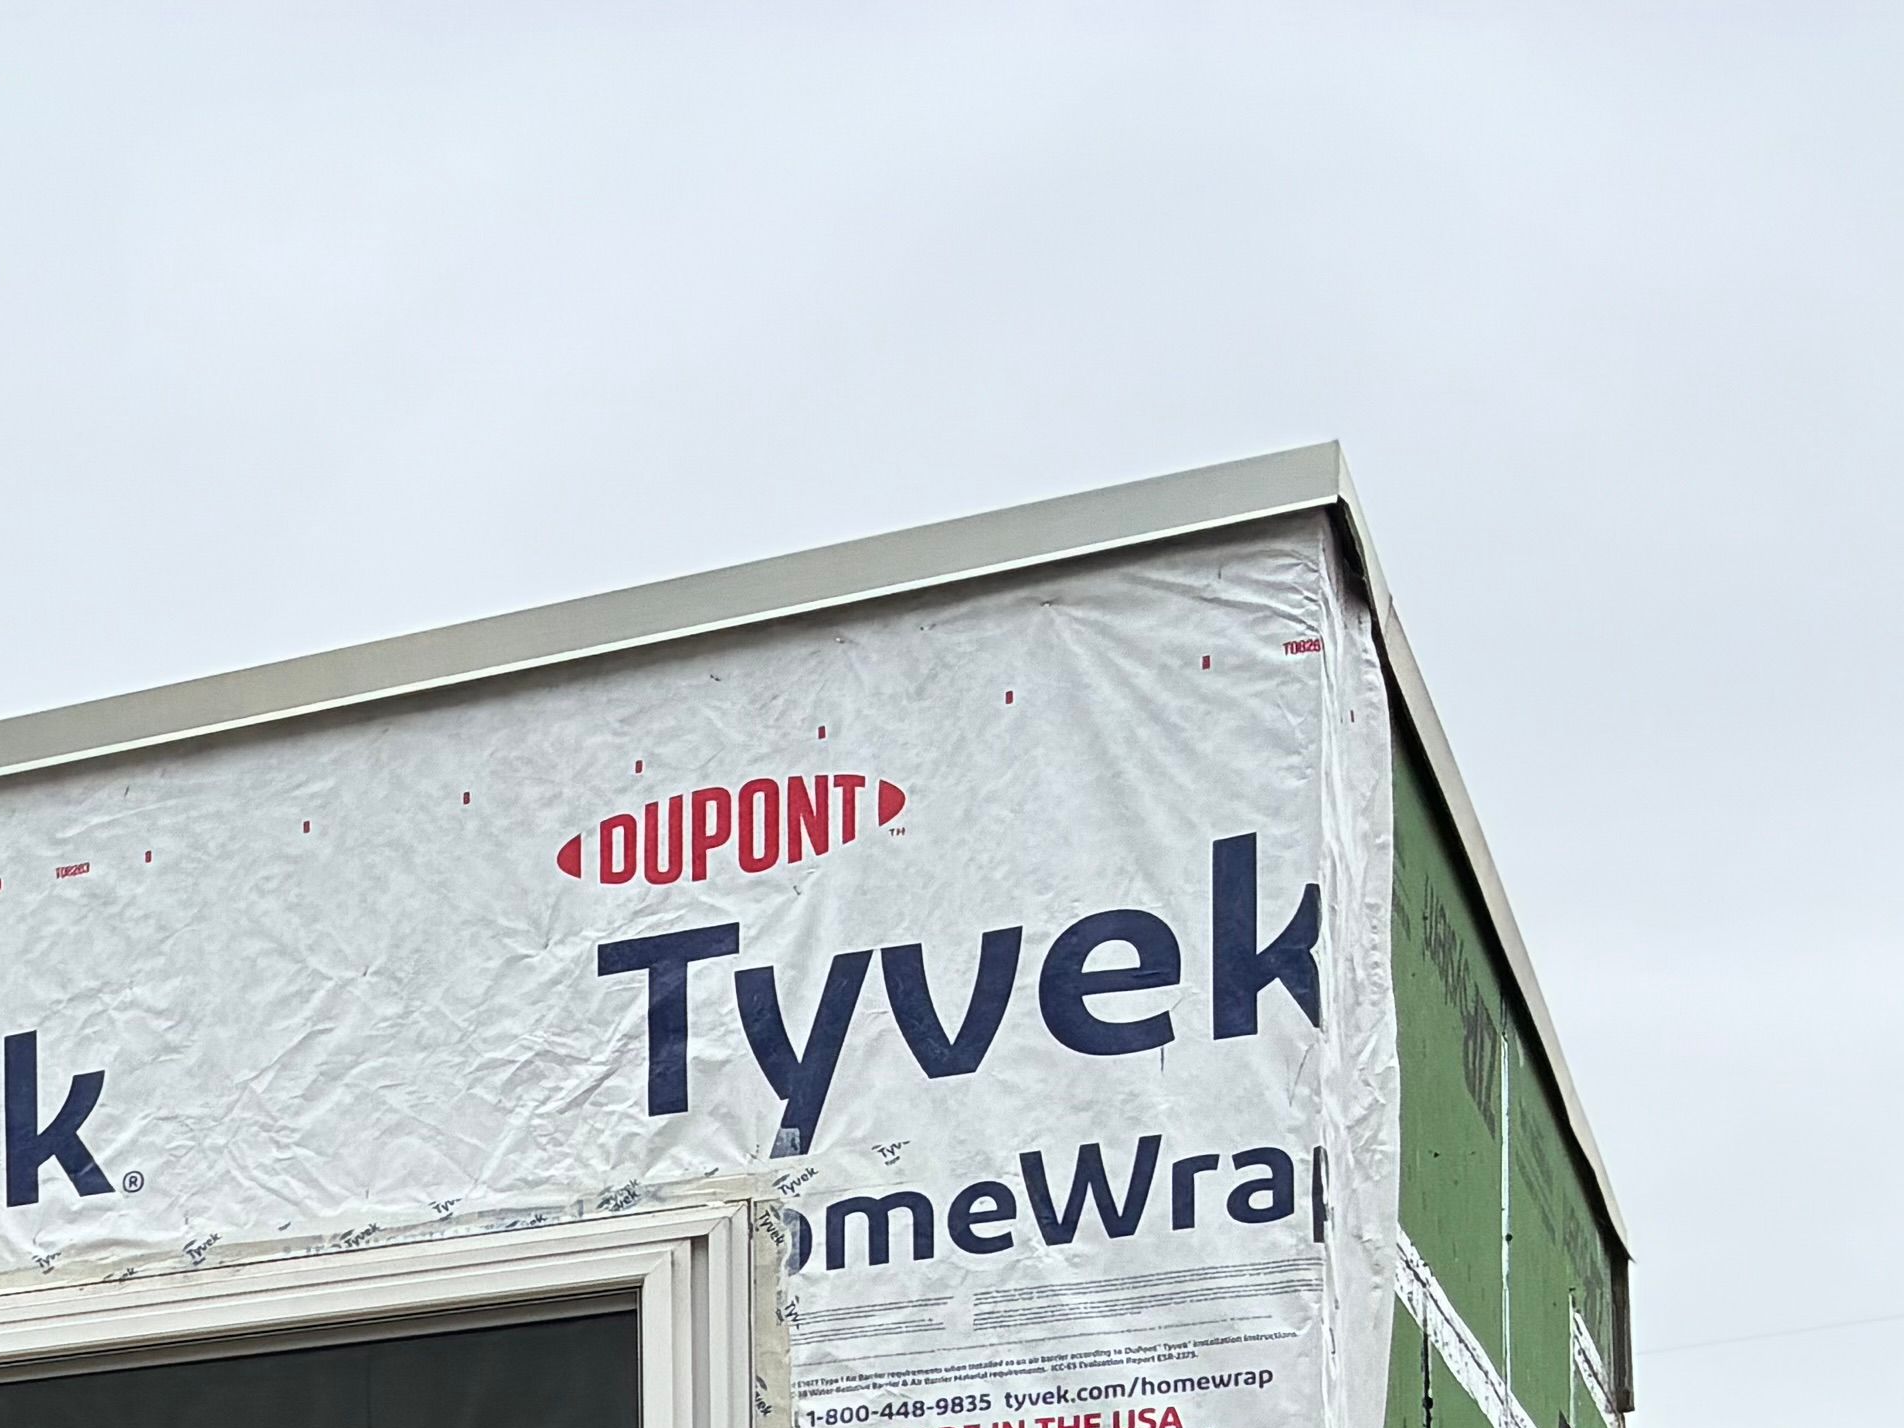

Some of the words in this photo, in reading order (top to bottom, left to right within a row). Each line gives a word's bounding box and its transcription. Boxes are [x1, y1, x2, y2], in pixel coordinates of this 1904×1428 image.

[600, 774, 865, 886] DUPONT
[597, 832, 1320, 1159] Tyvek
[778, 1168, 819, 1195] Tyvek
[783, 1134, 1325, 1277] meWra
[759, 1210, 784, 1246] Tyvek
[806, 1393, 991, 1428] 1-800-448-9835
[1004, 1368, 1273, 1412] tyvek.com/homewrap
